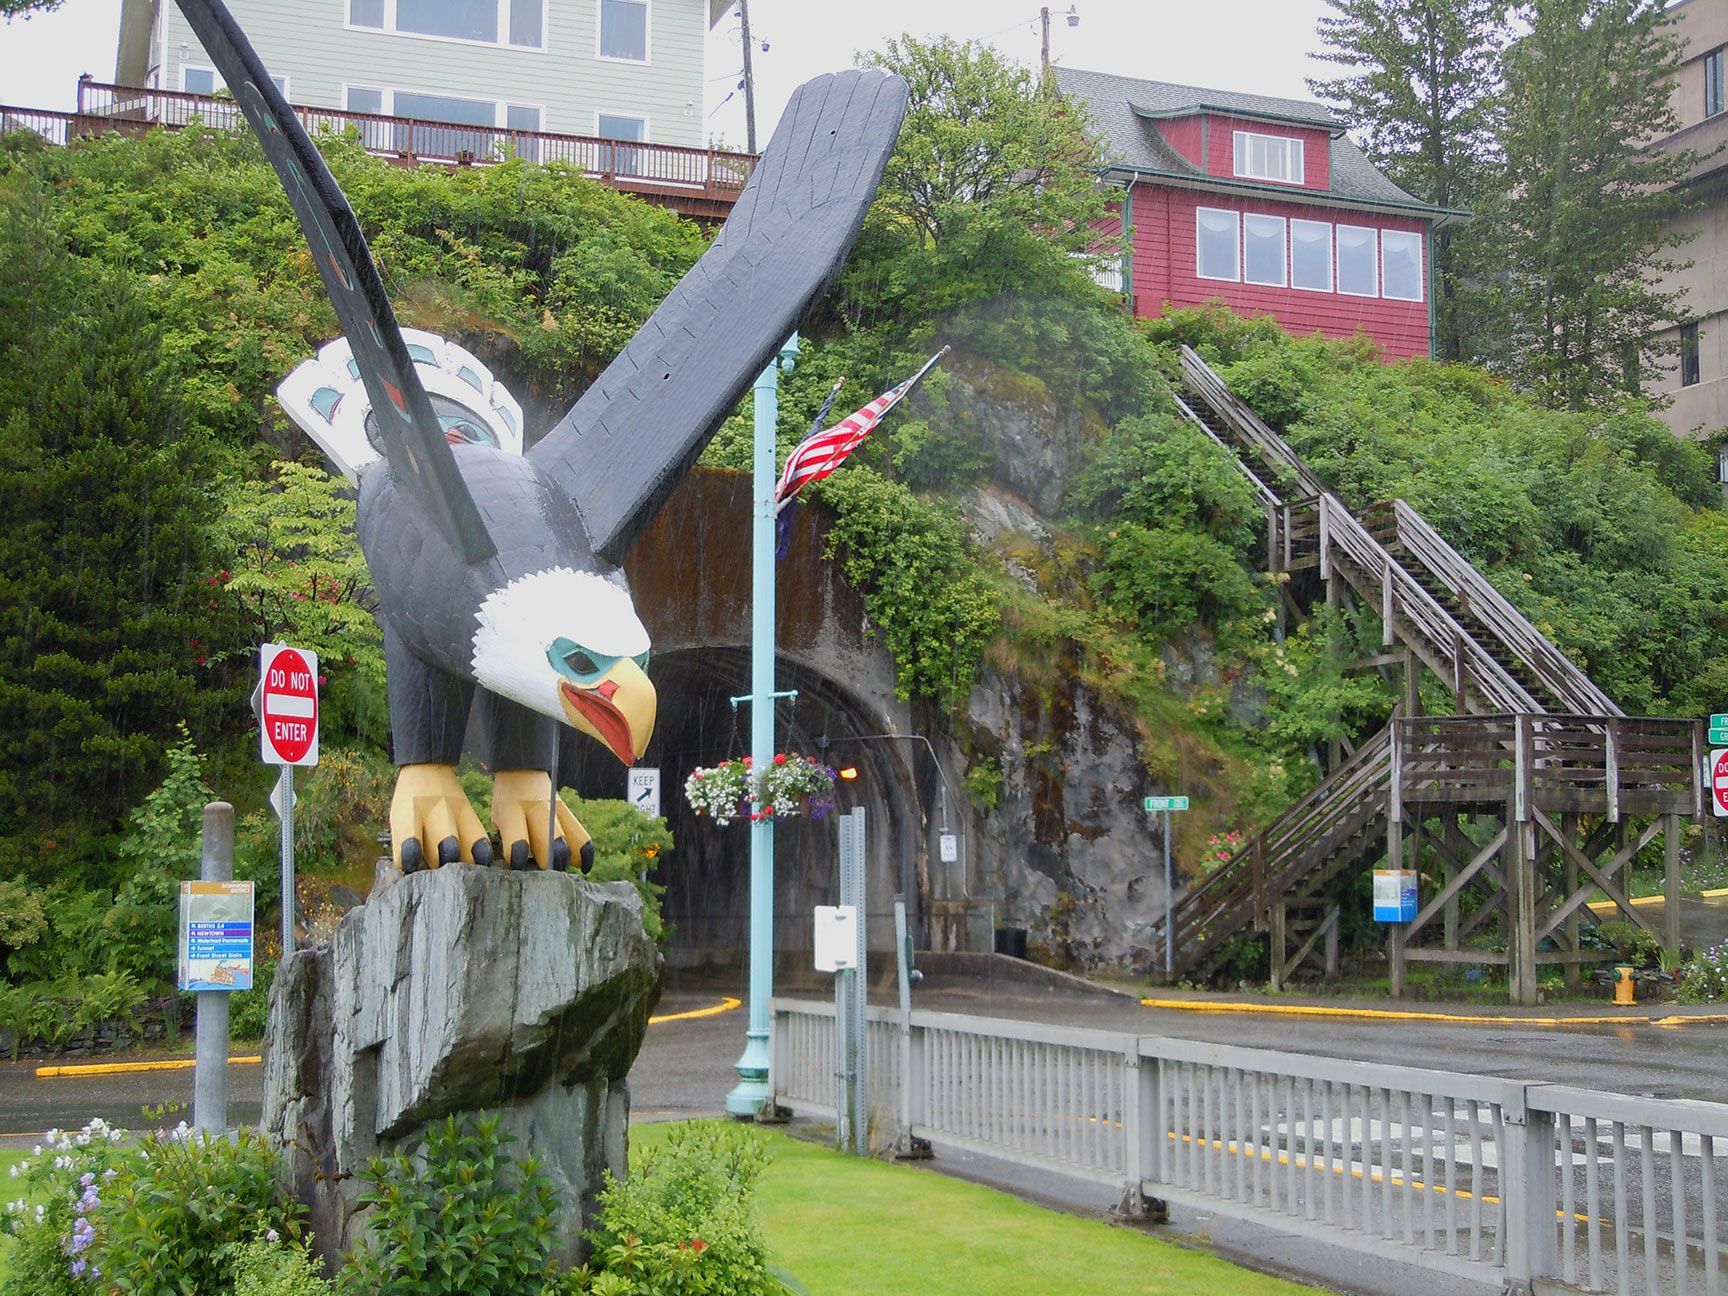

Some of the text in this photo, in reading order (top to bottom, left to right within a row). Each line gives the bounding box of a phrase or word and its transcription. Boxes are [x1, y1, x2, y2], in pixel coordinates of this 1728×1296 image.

[271, 669, 310, 691] DO NOT
[274, 721, 307, 742] ENTER
[633, 775, 655, 786] KEEP
[1150, 799, 1169, 809] FRONT
